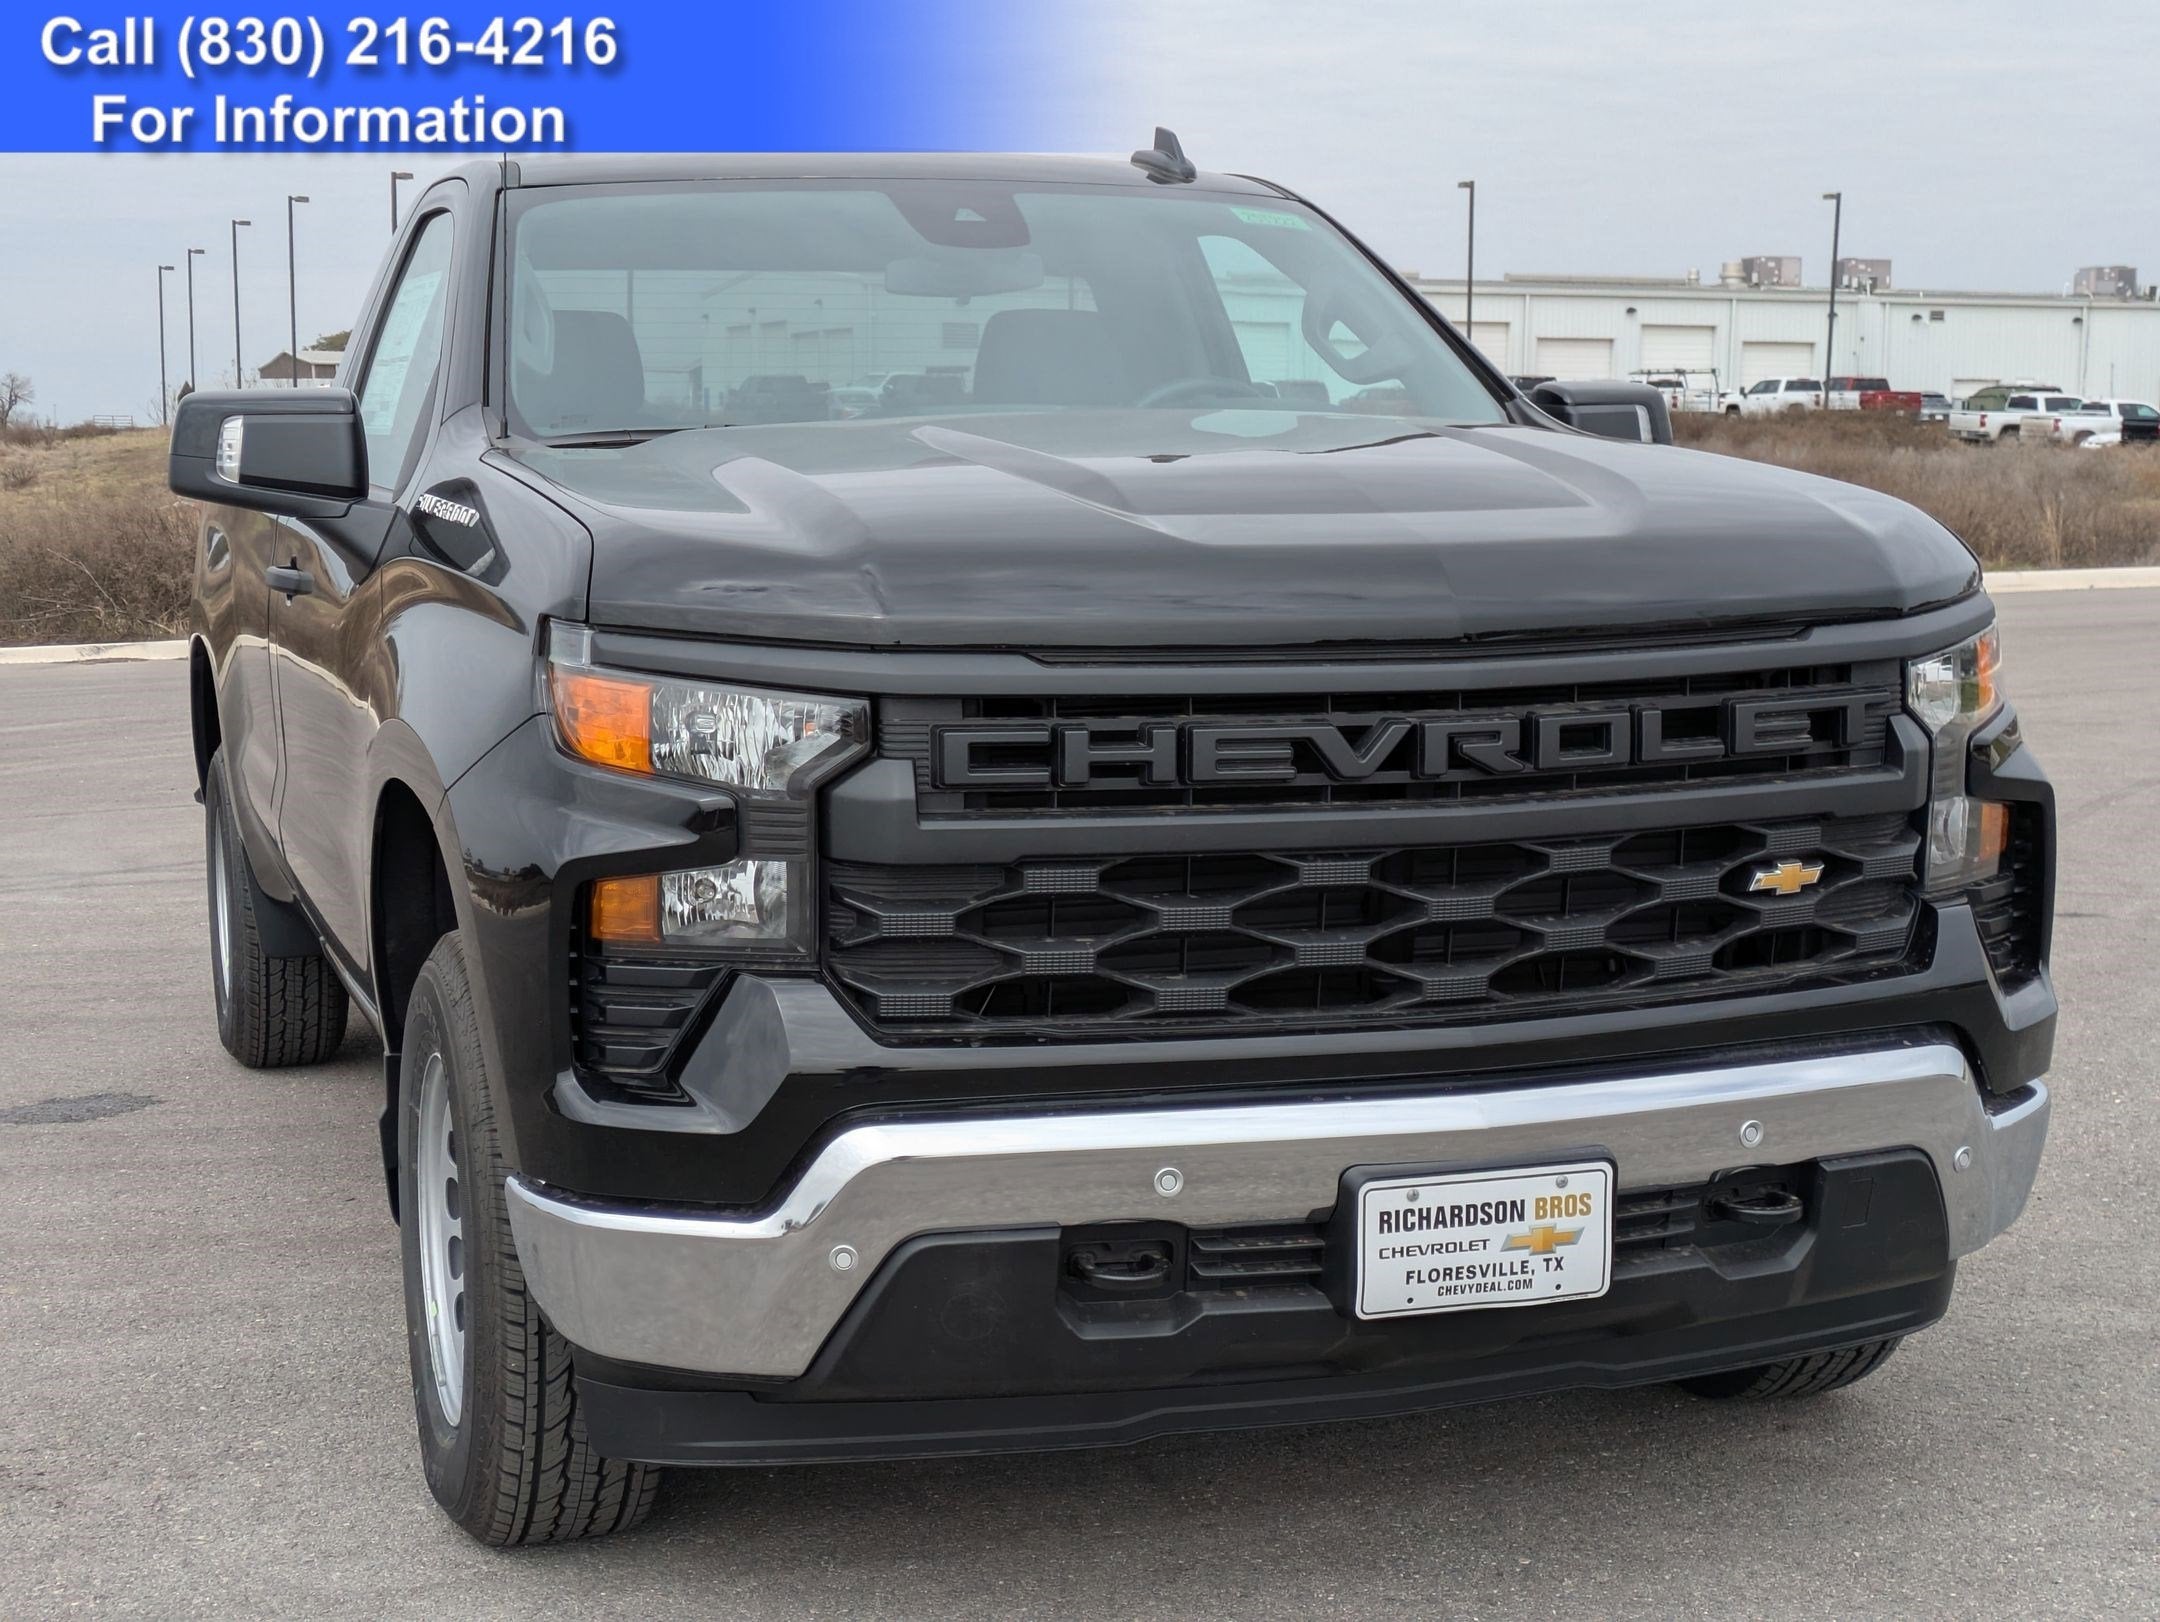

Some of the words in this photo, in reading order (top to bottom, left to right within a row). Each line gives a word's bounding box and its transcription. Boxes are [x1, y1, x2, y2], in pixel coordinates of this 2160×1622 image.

[931, 688, 1891, 790] CHEVROLET
[1378, 1199, 1526, 1235] RICHARDSON
[1534, 1192, 1593, 1221] BROS
[1378, 1238, 1491, 1260] CHEVROLET
[1405, 1260, 1536, 1286] FLORESVILLE,
[1543, 1256, 1565, 1273] TX
[1437, 1278, 1533, 1297] CHEVYDEAL.COM
